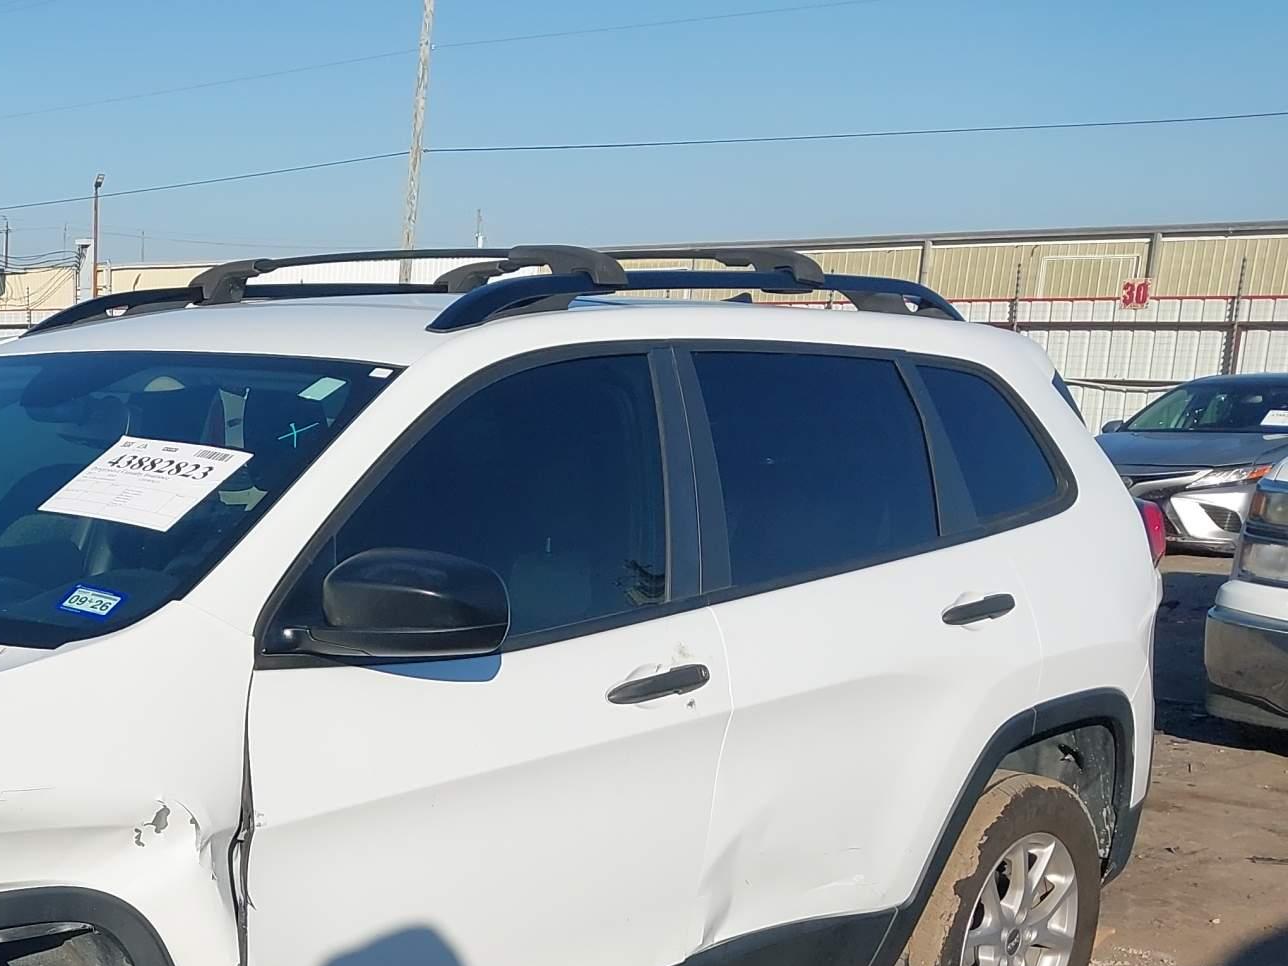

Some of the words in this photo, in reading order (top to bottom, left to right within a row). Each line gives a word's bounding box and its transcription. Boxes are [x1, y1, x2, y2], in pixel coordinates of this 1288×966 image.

[1123, 281, 1149, 305] 30
[107, 454, 214, 480] 43882823
[68, 595, 88, 605] 09
[90, 600, 112, 611] 26
